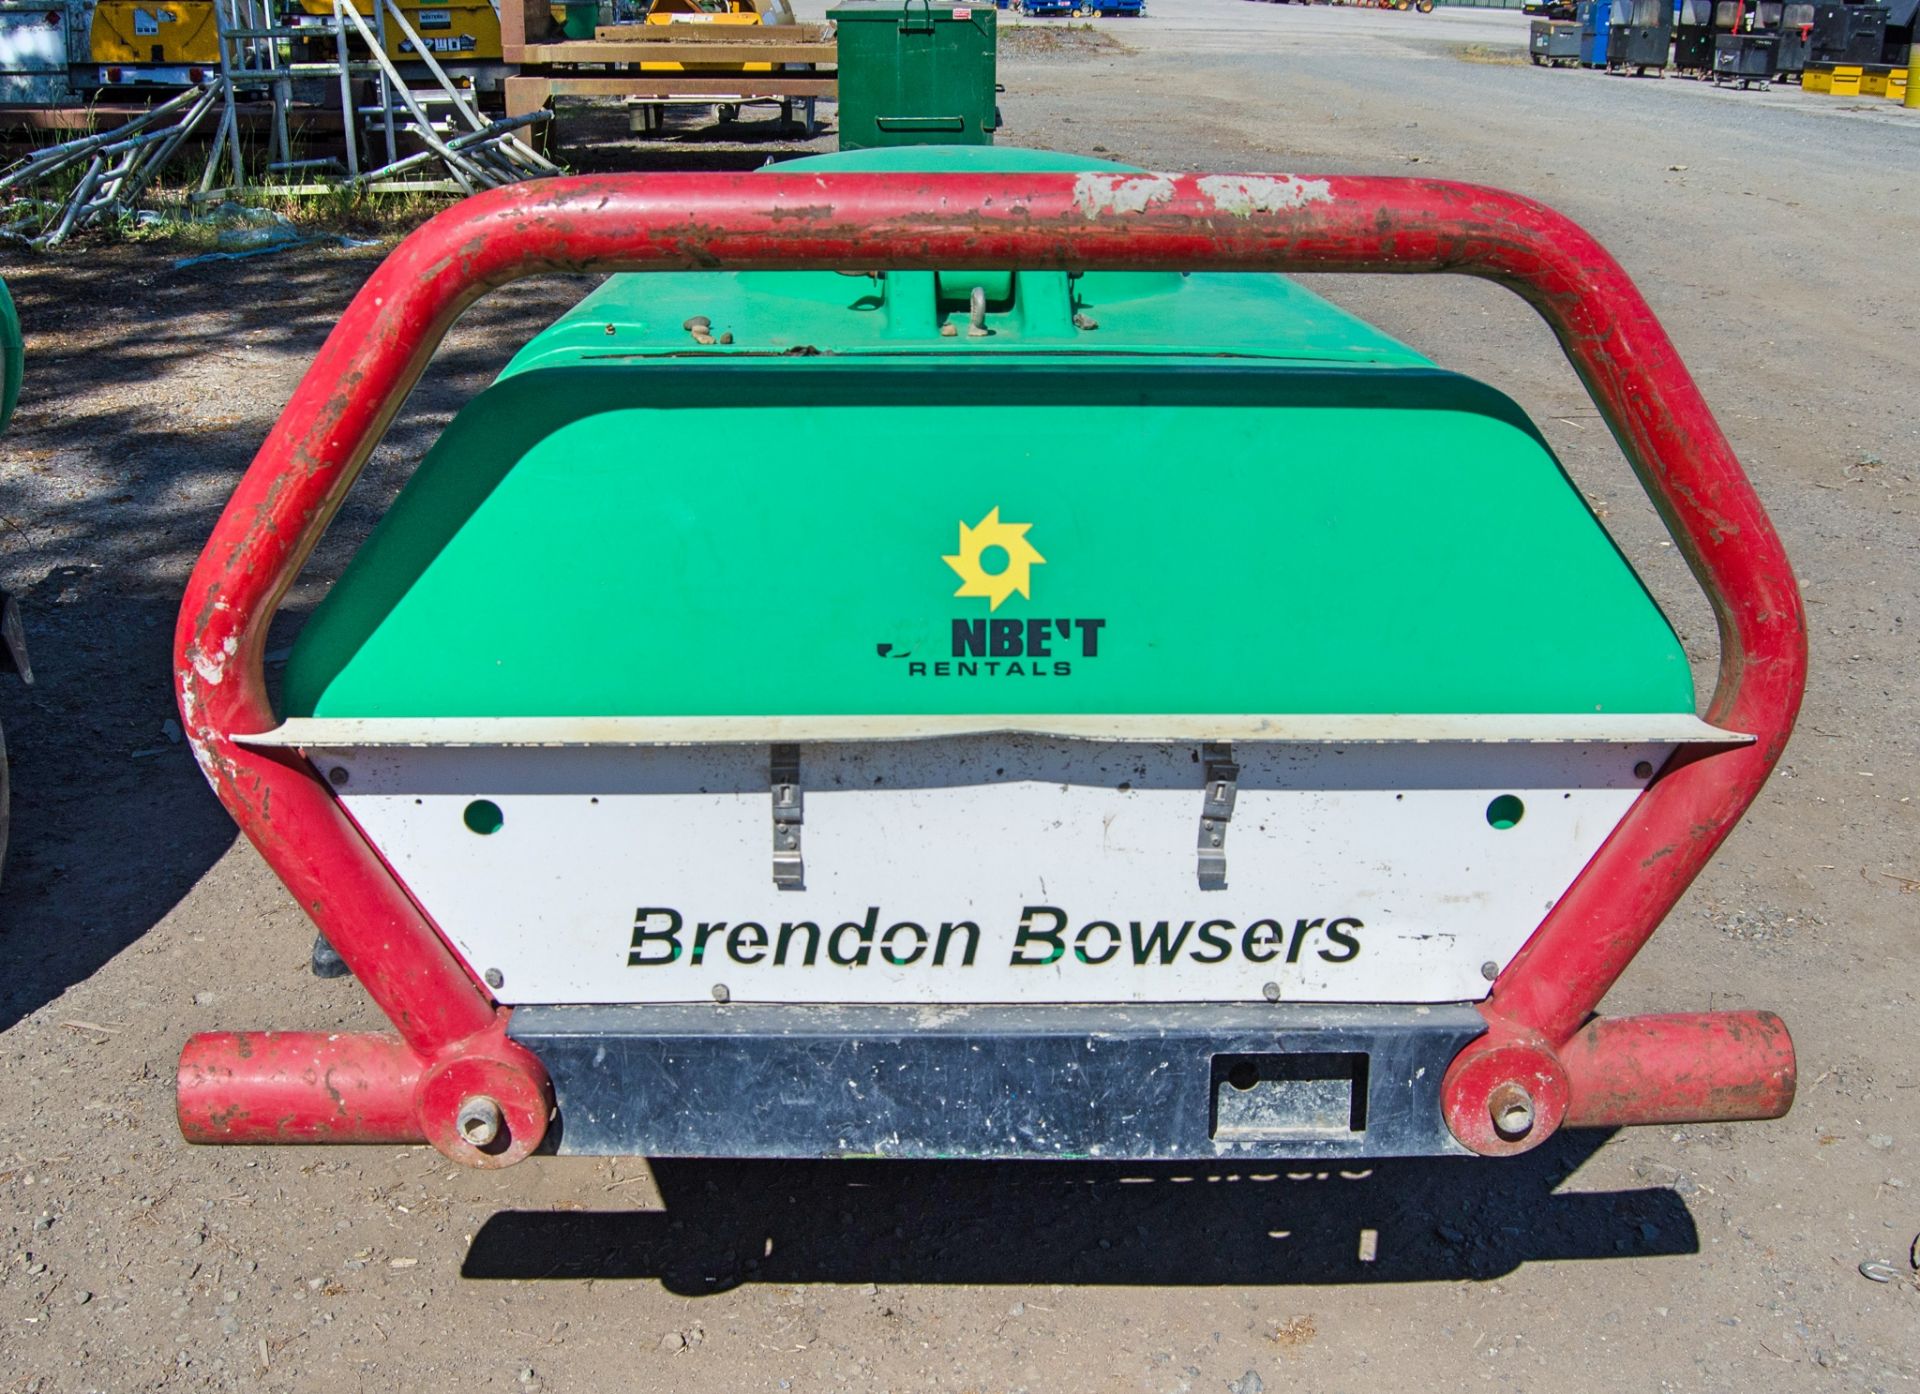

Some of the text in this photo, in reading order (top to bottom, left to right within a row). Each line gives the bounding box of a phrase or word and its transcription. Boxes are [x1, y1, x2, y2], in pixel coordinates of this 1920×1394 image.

[876, 618, 1106, 658] NBET
[908, 661, 1071, 677] RENTALS
[627, 904, 1364, 967] Brendon Bowsers
